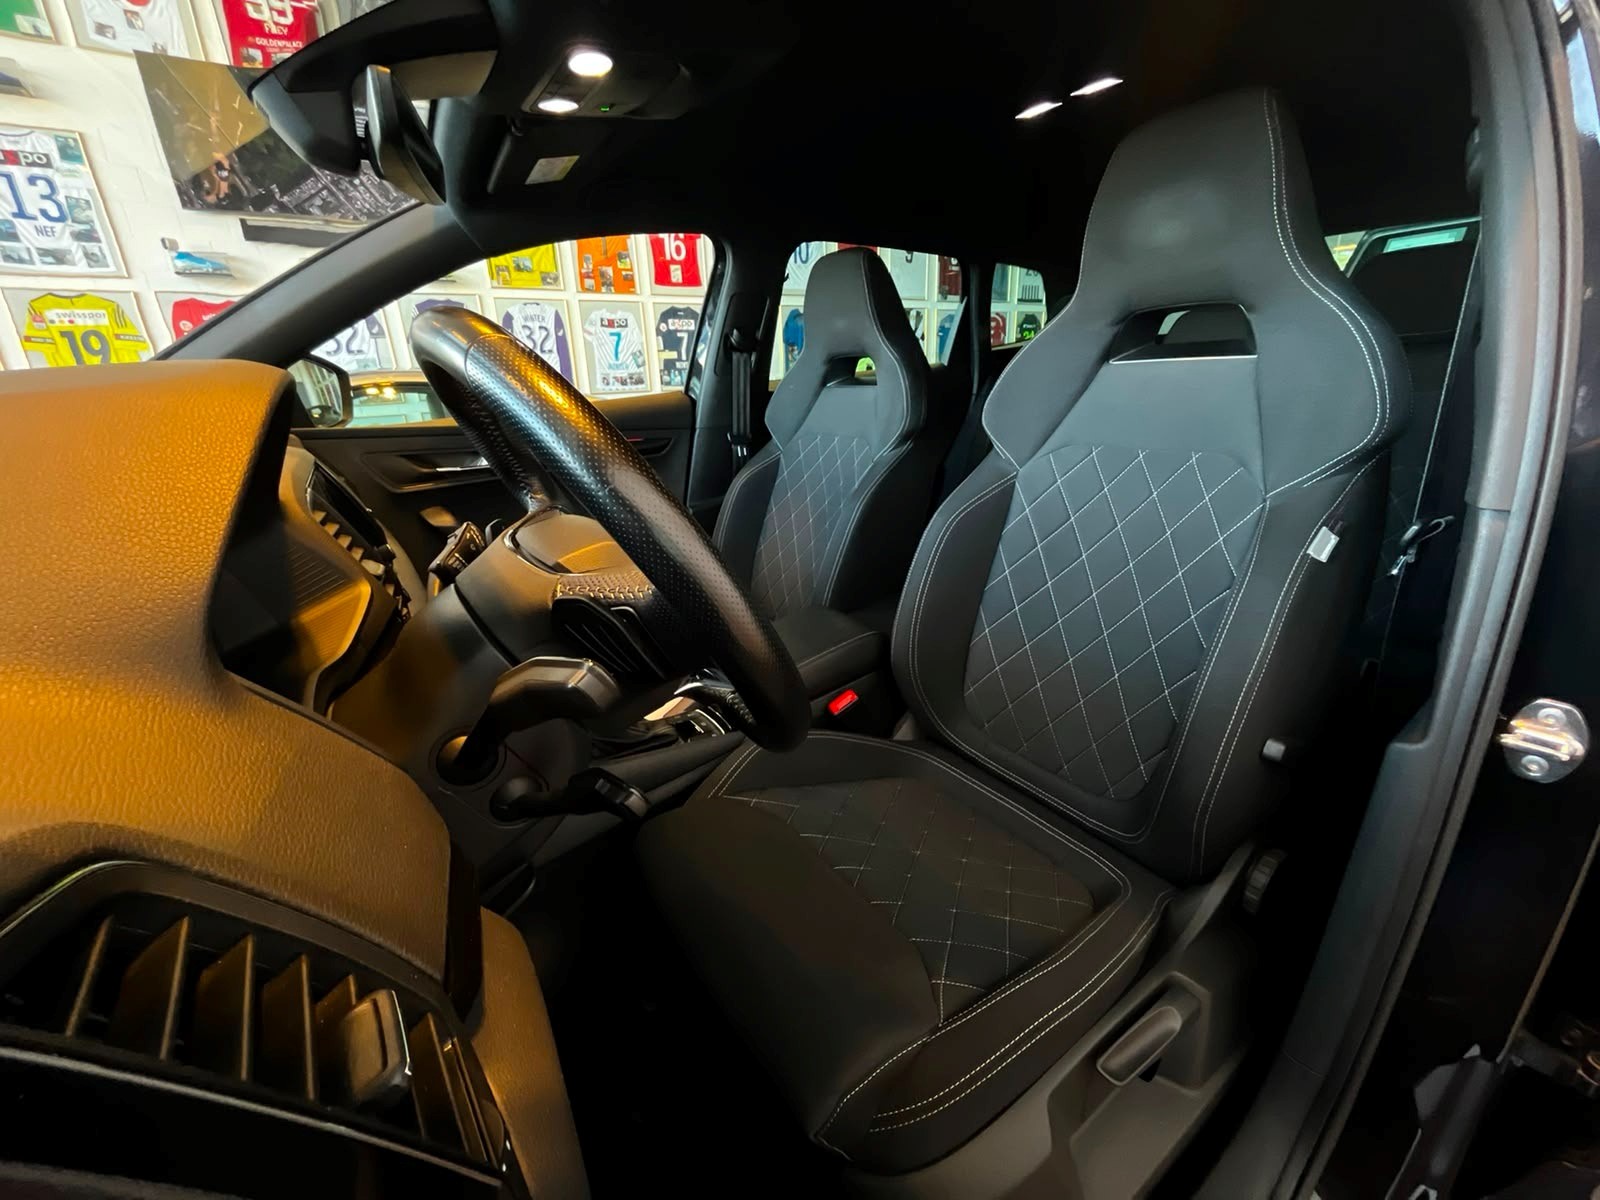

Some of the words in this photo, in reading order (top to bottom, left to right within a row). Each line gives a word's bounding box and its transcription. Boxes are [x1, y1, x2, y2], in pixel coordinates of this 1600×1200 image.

[0, 171, 68, 223] 13
[35, 225, 56, 238] NEF
[658, 232, 686, 261] 16
[60, 330, 111, 365] 19
[521, 324, 554, 353] 32
[609, 332, 621, 361] 7
[677, 331, 689, 361] 7
